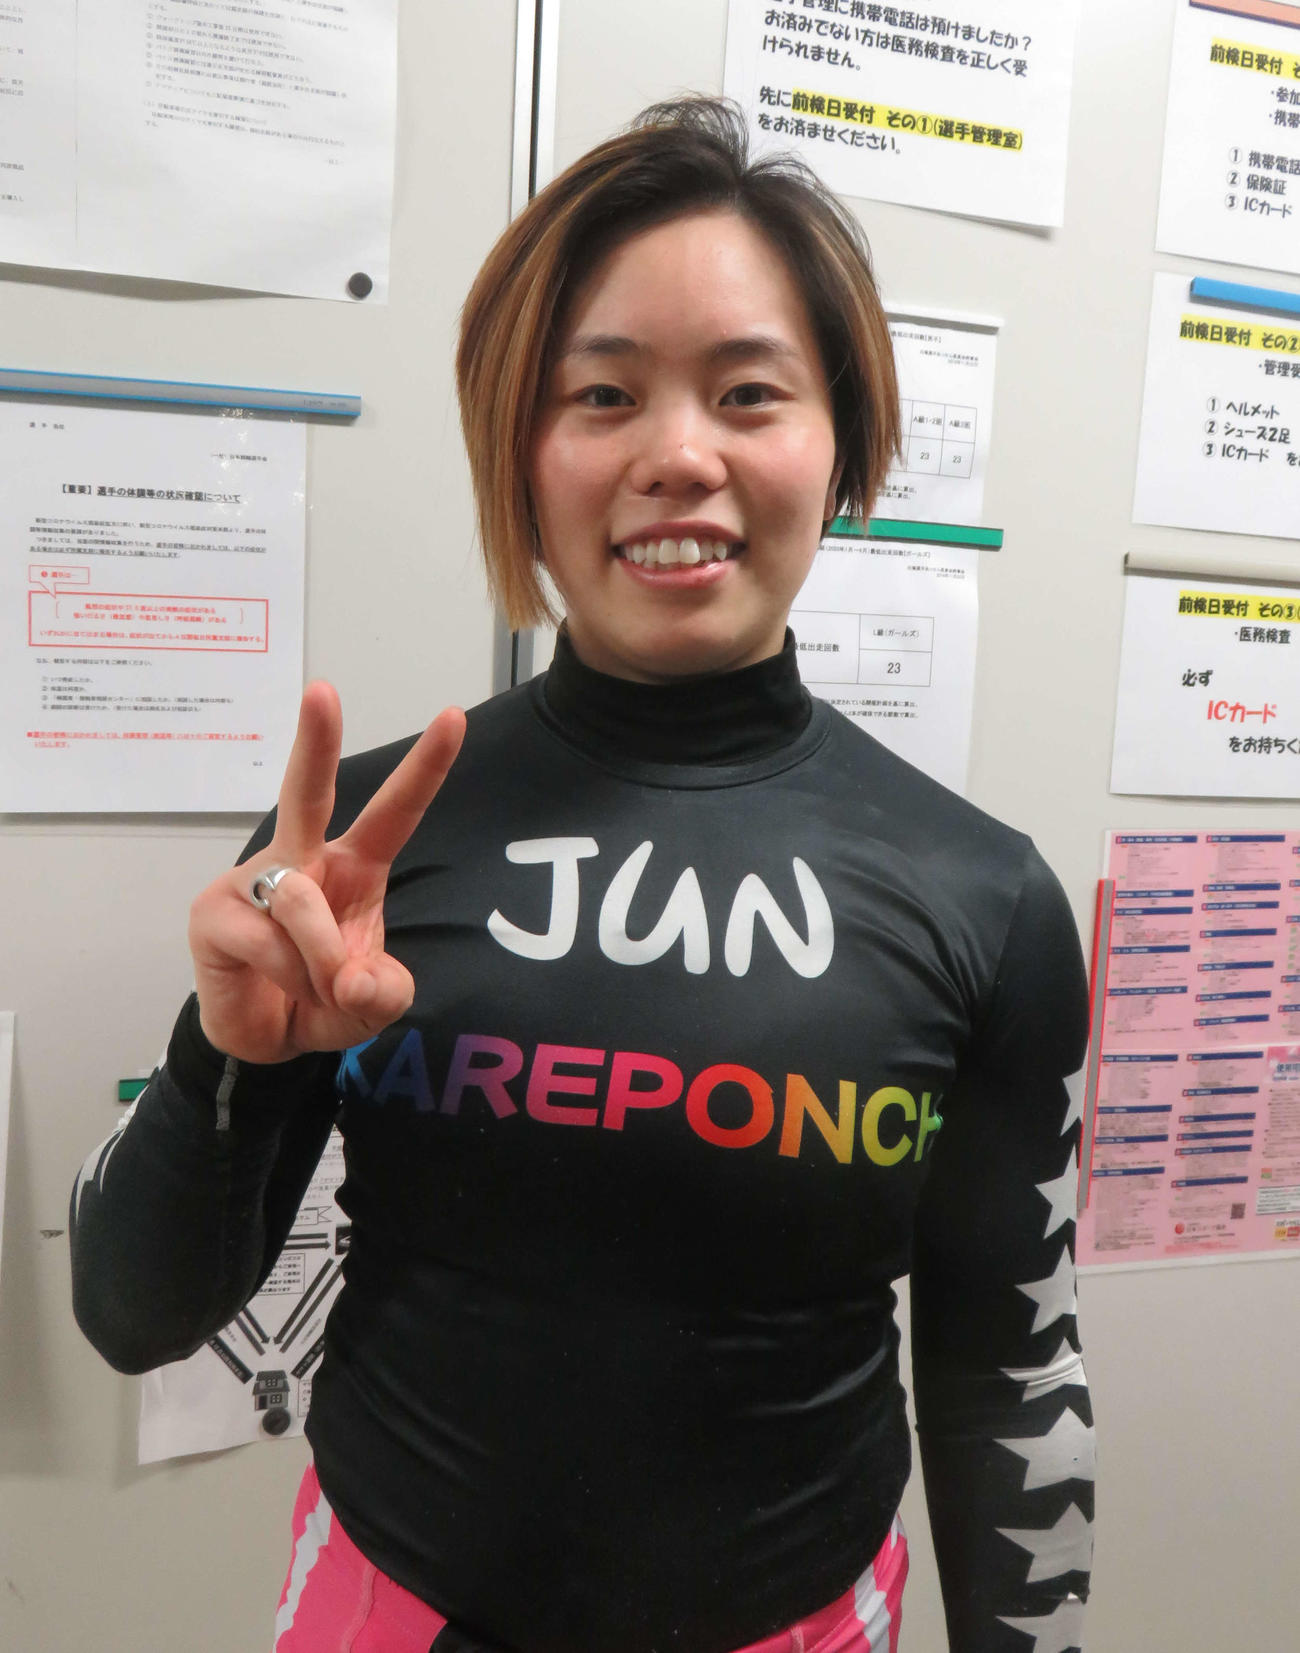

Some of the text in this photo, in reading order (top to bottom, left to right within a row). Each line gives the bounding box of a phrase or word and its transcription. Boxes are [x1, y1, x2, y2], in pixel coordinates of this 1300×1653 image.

[762, 34, 862, 71] けられません。
[764, 9, 1028, 77] お済みでない方は医務検査を正しく受
[1210, 43, 1283, 75] 前検日受付
[759, 85, 875, 124] 先に前検日受付
[757, 113, 902, 155] をお済ませください。
[1246, 173, 1287, 196] 保険証
[1244, 196, 1292, 219] ICカード
[1180, 320, 1253, 347] 前検日受付
[1225, 400, 1280, 420] ヘルメット
[1223, 421, 1291, 445] シューズ2足
[919, 451, 962, 464] 23 23
[1221, 443, 1269, 463] ICカード
[1178, 596, 1249, 617] 前検日受付
[887, 662, 902, 675] 23
[1182, 668, 1214, 687] 必ず
[1207, 699, 1277, 724] ICカード
[1229, 735, 1300, 755] をお持ちく
[486, 836, 836, 979] JUN
